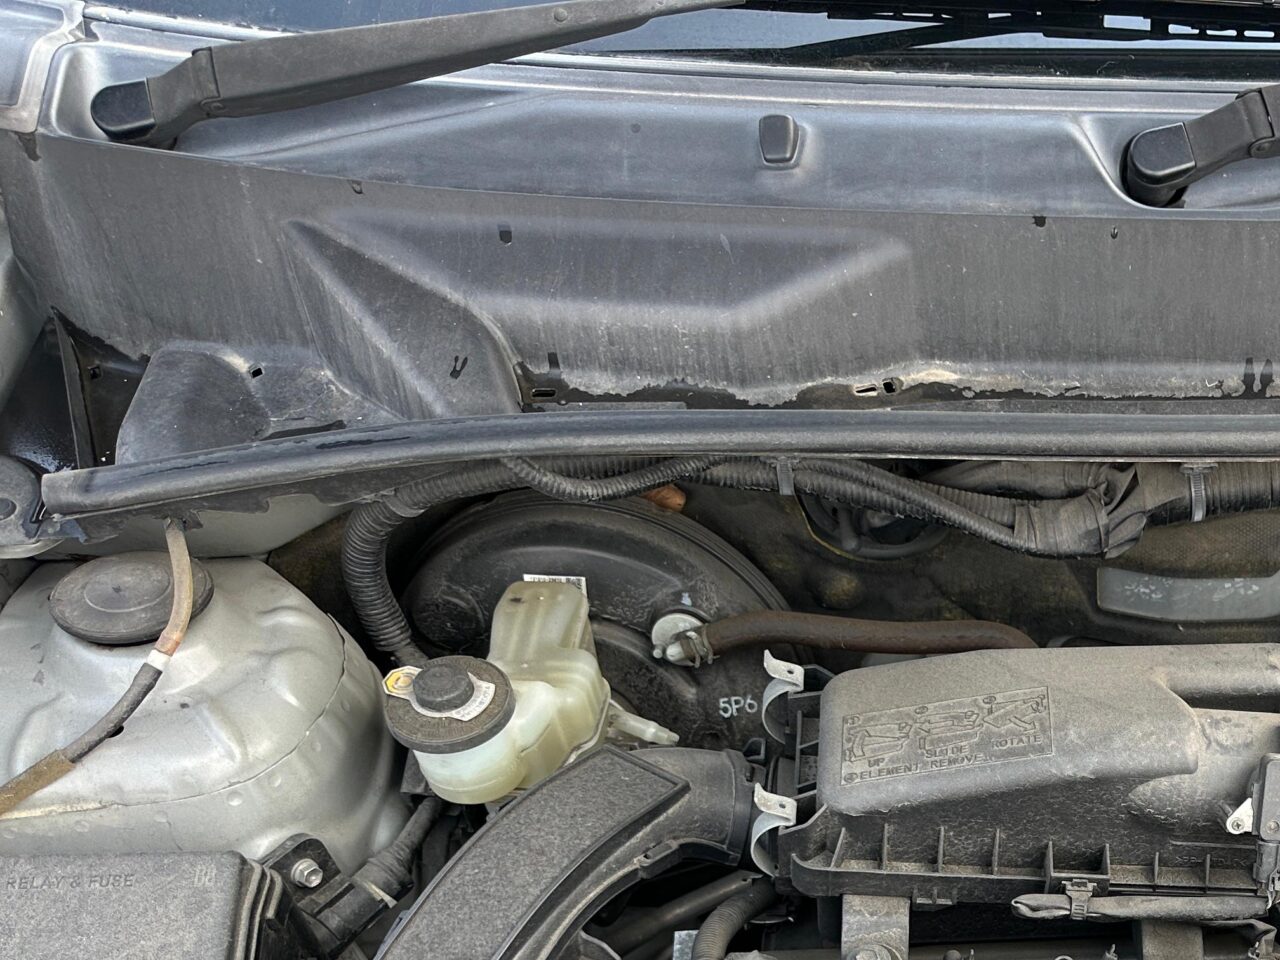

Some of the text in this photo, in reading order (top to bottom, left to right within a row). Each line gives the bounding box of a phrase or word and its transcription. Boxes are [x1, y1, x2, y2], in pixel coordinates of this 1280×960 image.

[719, 694, 758, 718] 5P6
[991, 734, 1042, 750] ROTATE
[867, 757, 885, 768] UP
[6, 873, 135, 890] RELAY & FUSE
